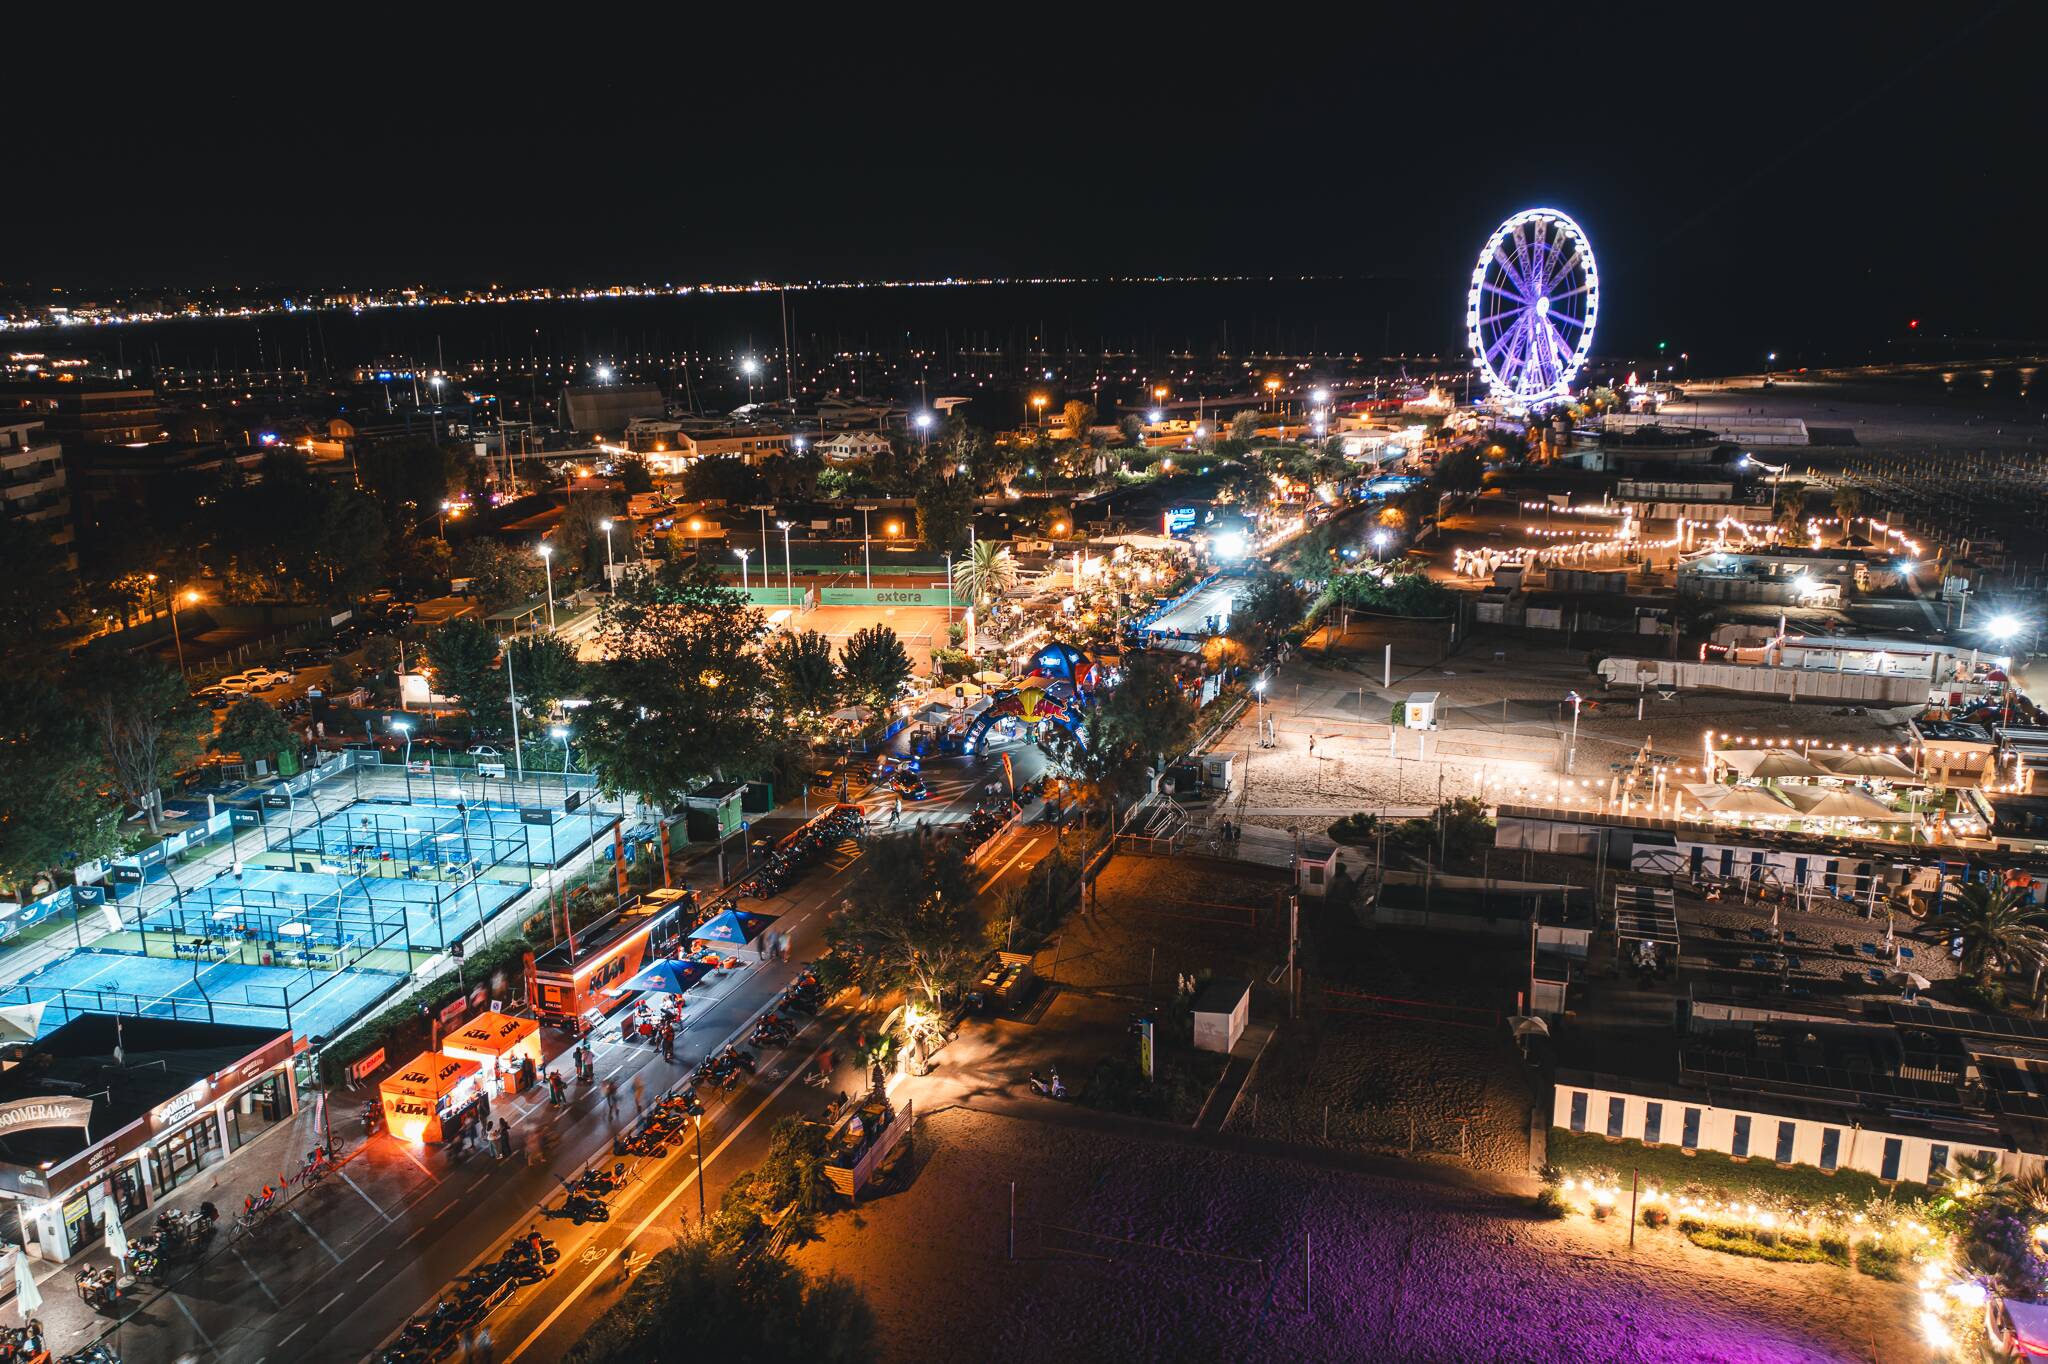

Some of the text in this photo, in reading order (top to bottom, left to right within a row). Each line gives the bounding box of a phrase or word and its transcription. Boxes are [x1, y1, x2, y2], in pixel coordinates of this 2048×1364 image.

[877, 591, 922, 602] extera
[588, 955, 626, 994] KTM
[463, 1029, 491, 1041] KTM
[500, 1021, 521, 1038] KTM
[400, 1071, 430, 1084] KTM
[439, 1062, 462, 1080] KTM
[402, 1087, 415, 1096] KTM
[395, 1102, 429, 1116] KTM
